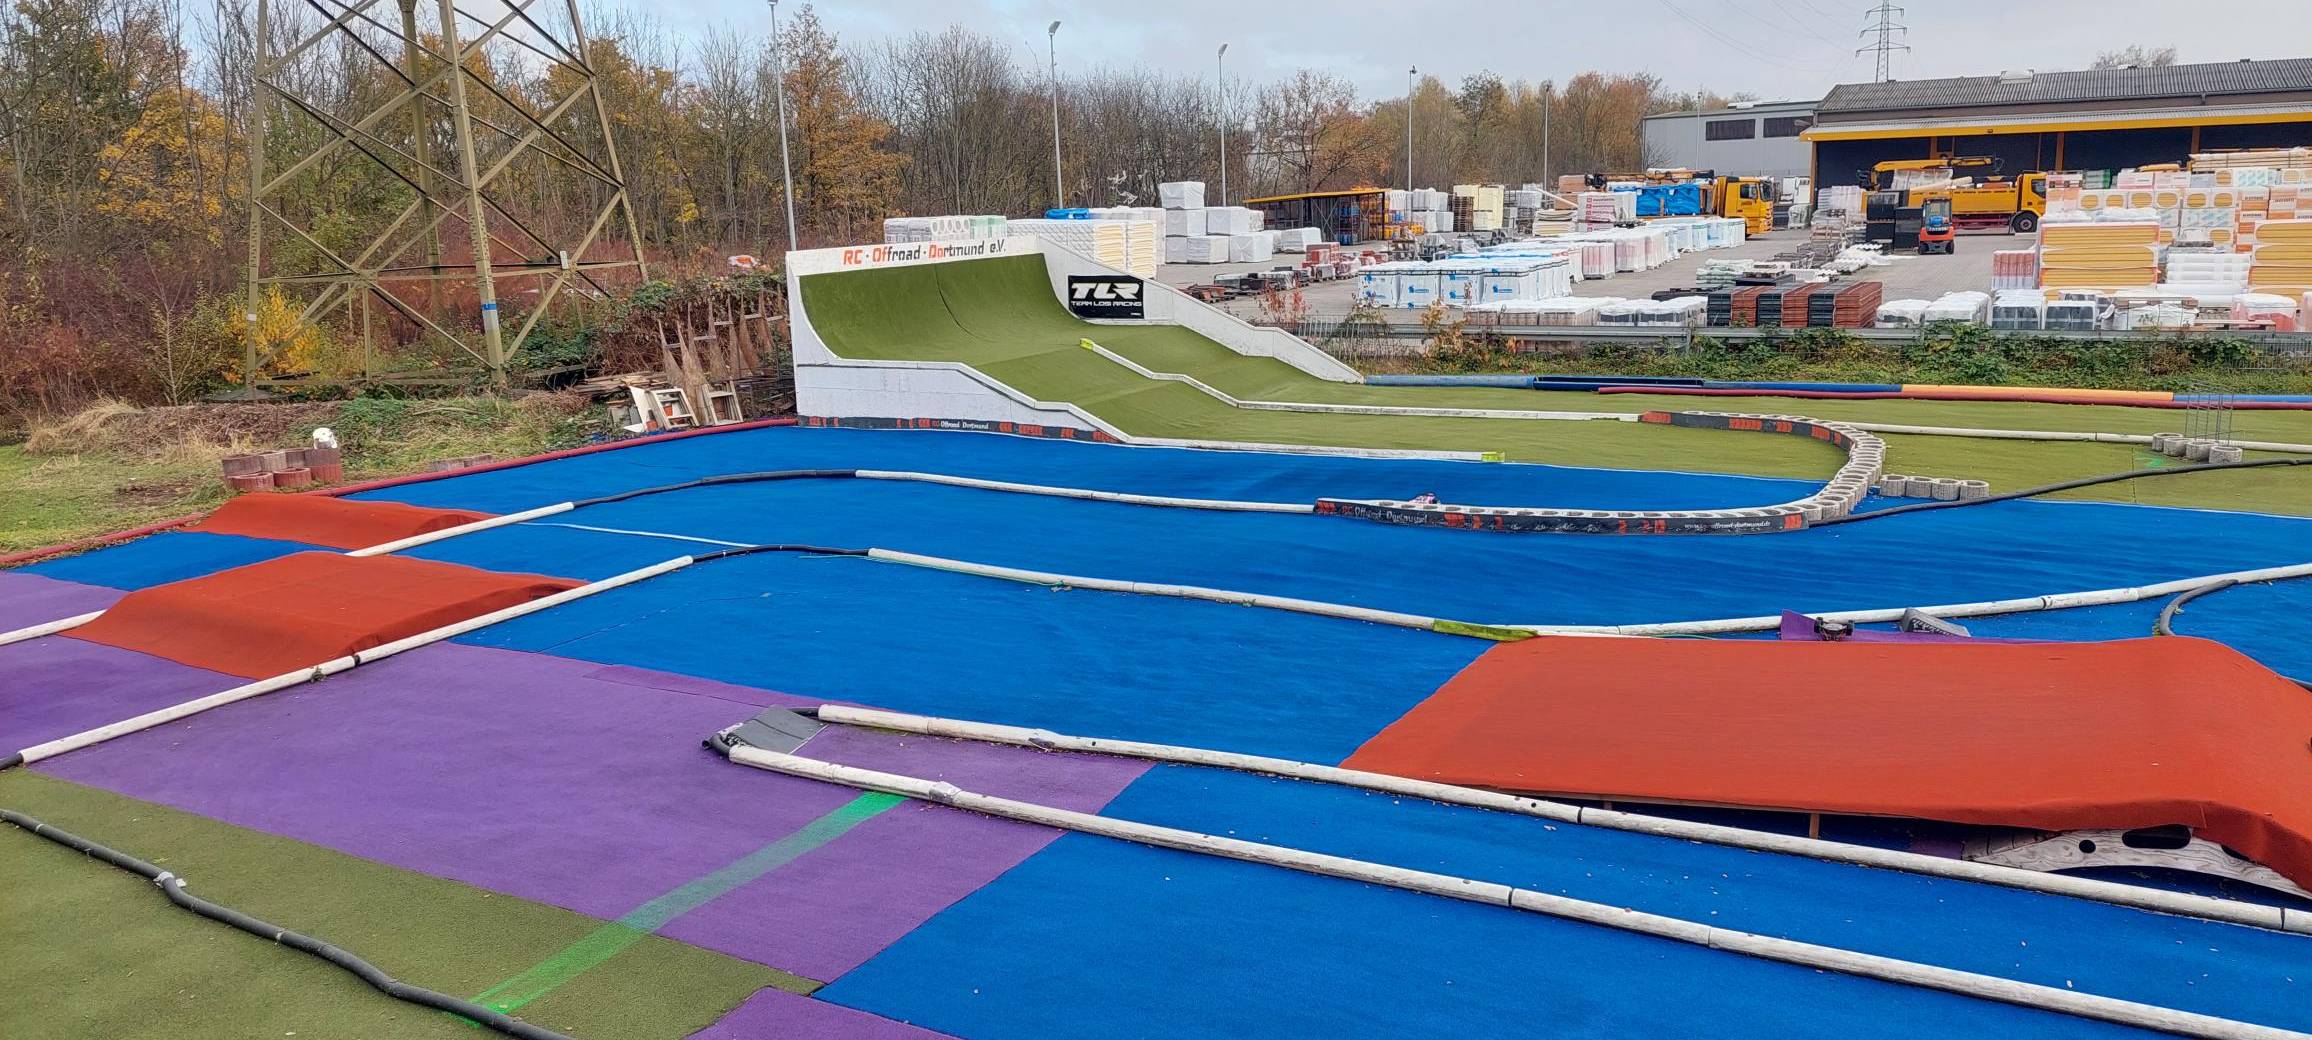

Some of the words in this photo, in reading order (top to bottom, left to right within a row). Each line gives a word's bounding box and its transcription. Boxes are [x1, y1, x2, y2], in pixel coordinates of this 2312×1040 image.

[843, 249, 863, 265] RC
[872, 245, 921, 262] Offroad
[928, 240, 985, 259] Dortmund
[989, 239, 1006, 253] e.V.
[1071, 282, 1140, 299] TLR
